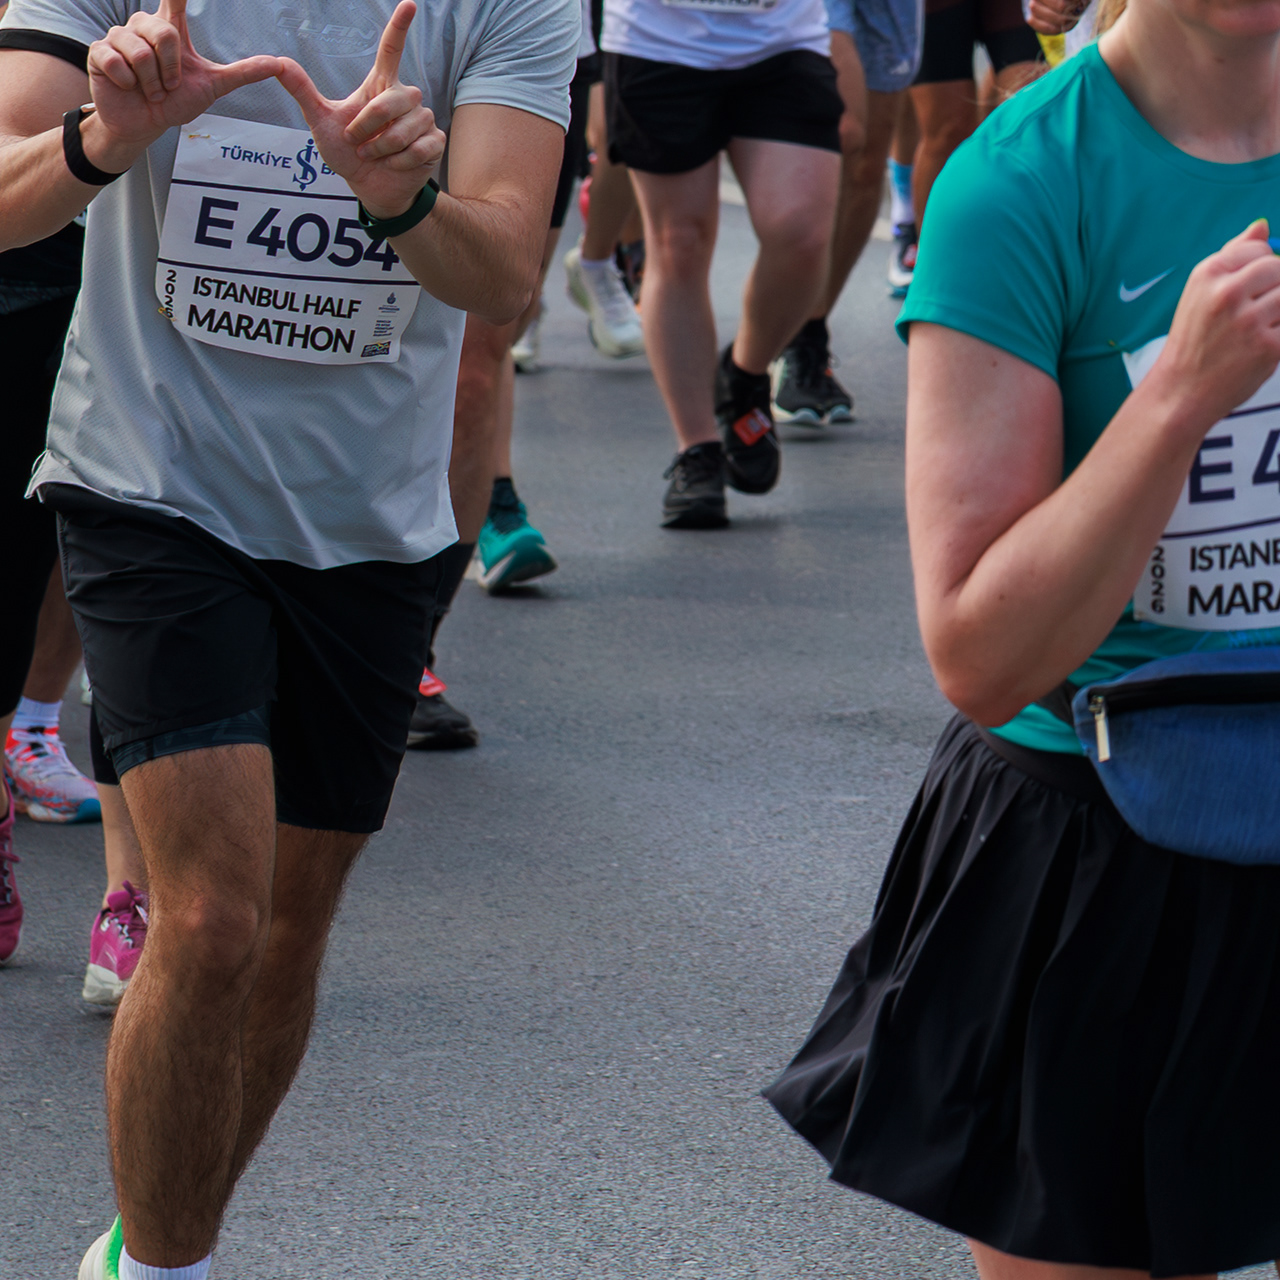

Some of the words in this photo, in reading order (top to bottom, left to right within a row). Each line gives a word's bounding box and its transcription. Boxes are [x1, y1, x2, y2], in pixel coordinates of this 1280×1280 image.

[221, 145, 292, 169] TÜRKİYE
[194, 196, 239, 249] E
[246, 207, 400, 272] 4054
[193, 275, 299, 313] ISTANBUL
[302, 293, 362, 319] HALF
[187, 304, 356, 353] MARATHON
[1188, 435, 1235, 505] E
[1151, 546, 1165, 615] 2026
